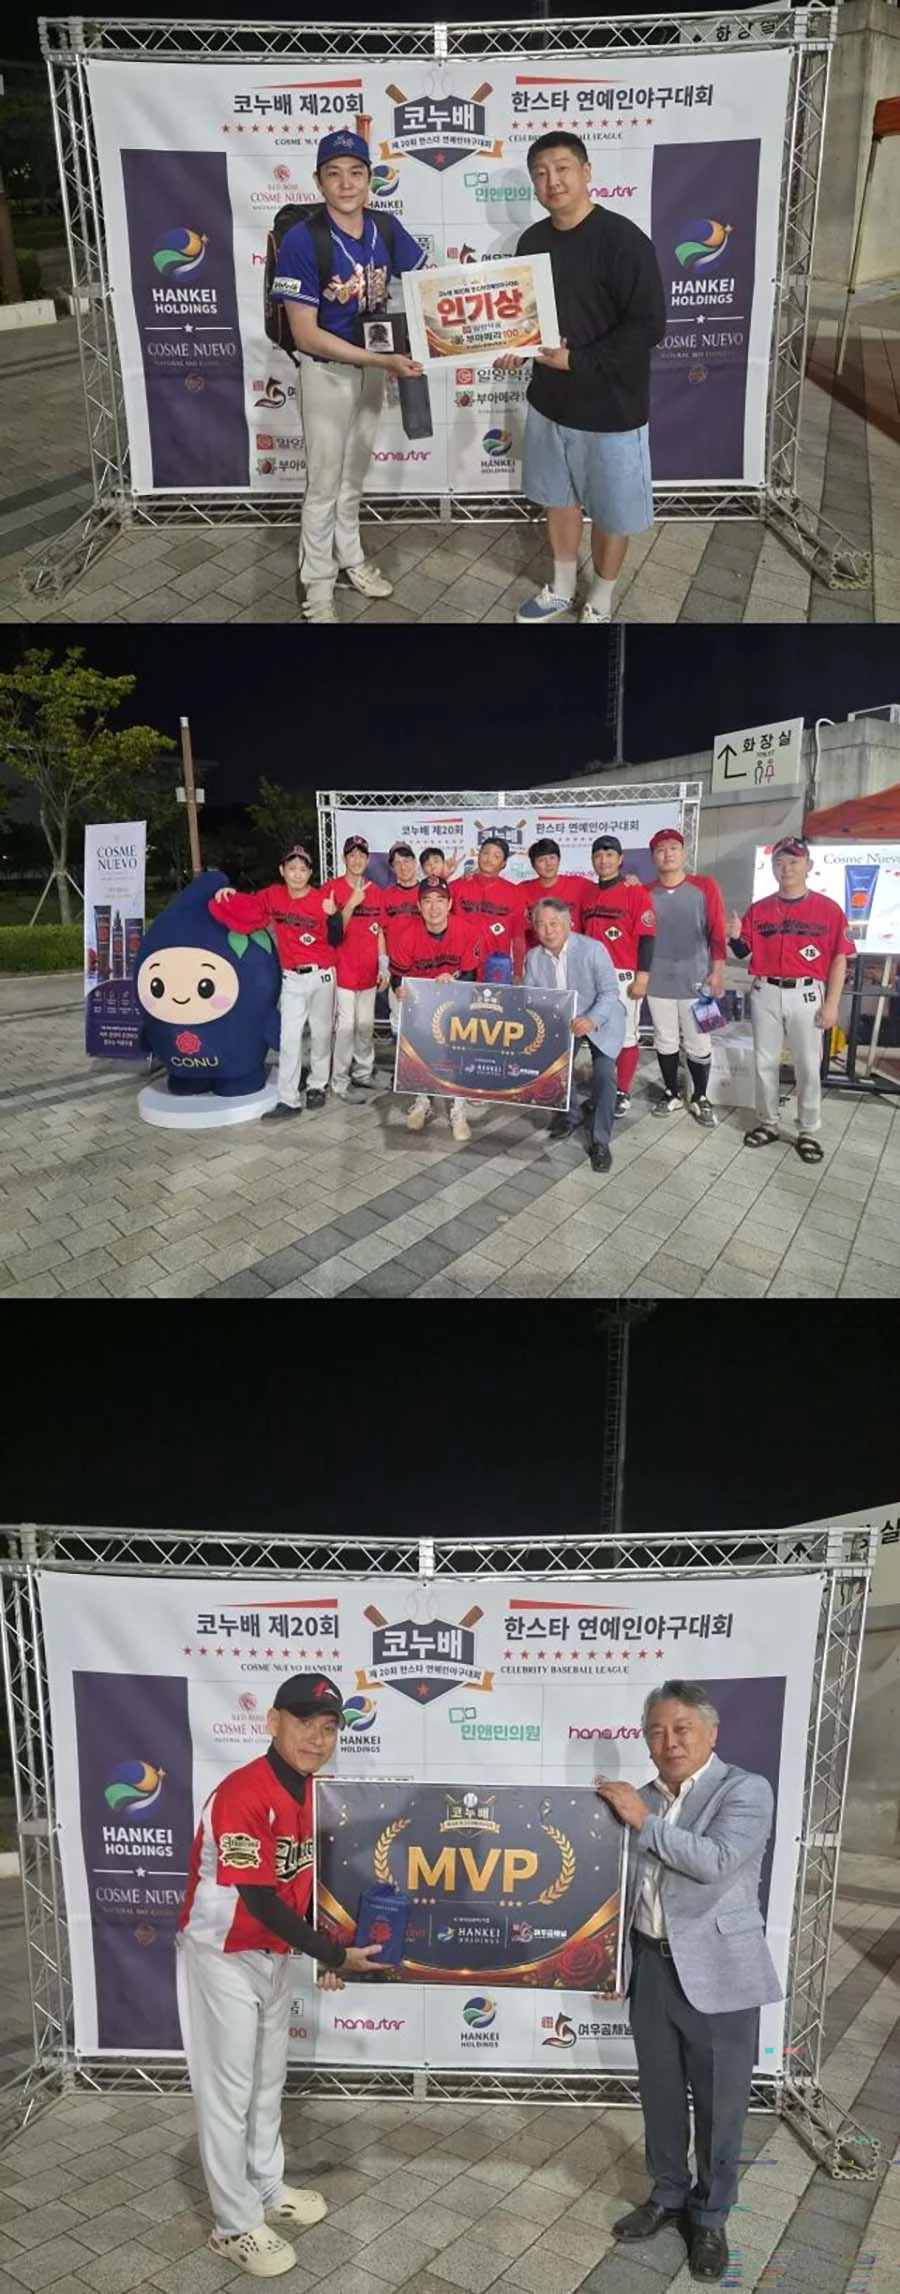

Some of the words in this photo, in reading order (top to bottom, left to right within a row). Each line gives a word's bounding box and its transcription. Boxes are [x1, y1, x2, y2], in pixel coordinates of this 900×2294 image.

[233, 94, 292, 115] 코누배
[299, 93, 364, 115] 제20회
[511, 90, 570, 113] 한스타
[576, 84, 714, 110] 연예인야구대회
[402, 104, 475, 131] 코누배
[671, 278, 736, 296] HANKEI
[152, 288, 217, 303] HANKEI
[671, 295, 734, 307] HOLDINGS
[155, 303, 218, 314] HOLDINGS
[437, 288, 524, 328] 인기상
[701, 332, 744, 347] NUEVO
[147, 342, 190, 357] COSME
[193, 342, 237, 357] NUEVO
[742, 730, 792, 753] 화장실
[402, 824, 430, 836] 코누배
[432, 824, 464, 836] 제20회
[535, 822, 566, 834] 한스타
[568, 819, 640, 834] 연예인야구대회
[96, 844, 137, 858] COSME
[97, 858, 138, 871] NUEVO
[823, 853, 864, 865] Cosme
[805, 949, 816, 957] 15
[321, 974, 331, 983] 10
[802, 991, 817, 1004] 15
[450, 1016, 525, 1048] MVP
[171, 1055, 219, 1069] CONU
[196, 1613, 261, 1638] 코누배
[268, 1613, 340, 1639] 제20회
[504, 1615, 570, 1641] 한스타
[577, 1613, 734, 1641] 연예인야구대회
[382, 1629, 463, 1660] 코누배
[240, 1663, 270, 1672] COSME
[273, 1664, 302, 1672] NUEVO
[500, 1665, 548, 1675] CELEBRITY
[550, 1665, 593, 1675] BASEBALL
[595, 1665, 630, 1674] LEAGUE
[212, 1723, 246, 1735] COSME
[340, 1735, 381, 1745] HANKEI
[103, 1826, 173, 1844] HANKEI
[105, 1844, 174, 1857] HOLDINGS
[407, 1845, 539, 1893] MVP
[96, 1886, 141, 1904] COSME
[145, 1888, 187, 1905] NUEV
[458, 1927, 501, 1938] HANKEI
[460, 2032, 500, 2041] HANKEI
[460, 2041, 499, 2049] HOLDINGS
